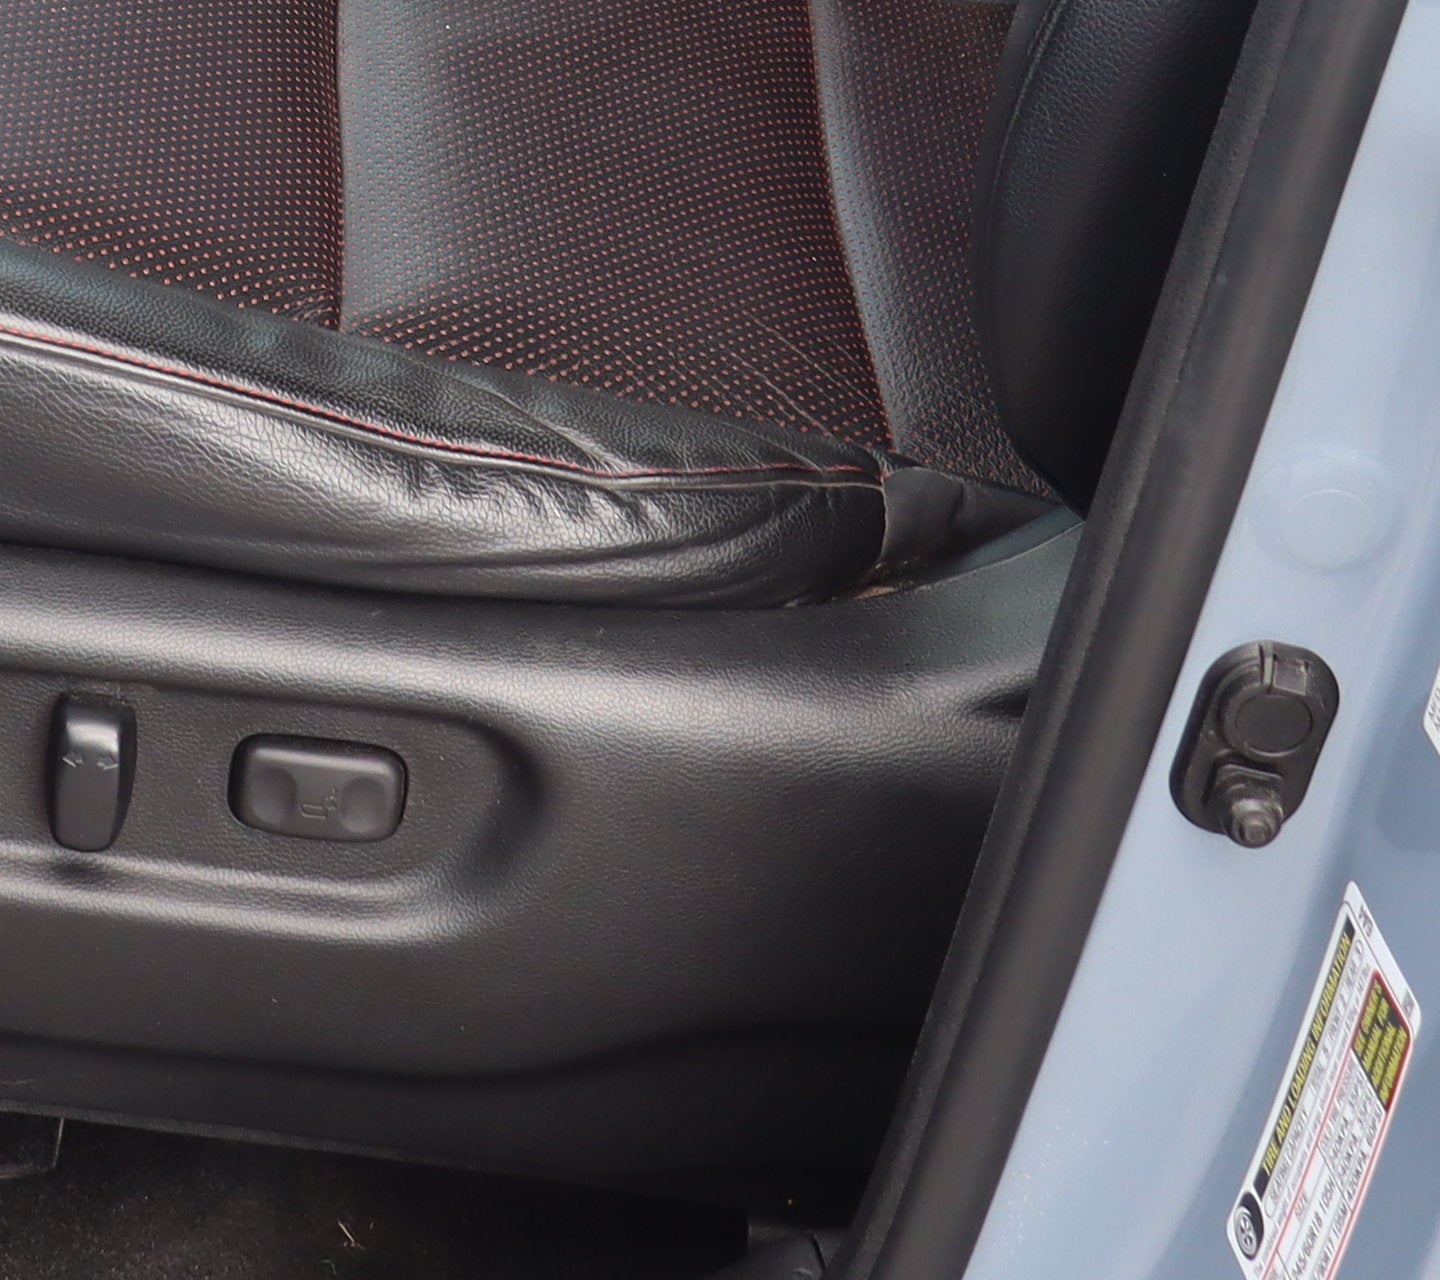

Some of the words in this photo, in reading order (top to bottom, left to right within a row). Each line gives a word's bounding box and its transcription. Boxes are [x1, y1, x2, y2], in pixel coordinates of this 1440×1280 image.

[1261, 1136, 1280, 1179] TIRE
[1274, 1101, 1292, 1146] AND
[1287, 1035, 1316, 1110] LOADING
[1310, 929, 1351, 1043] INFORMATION
